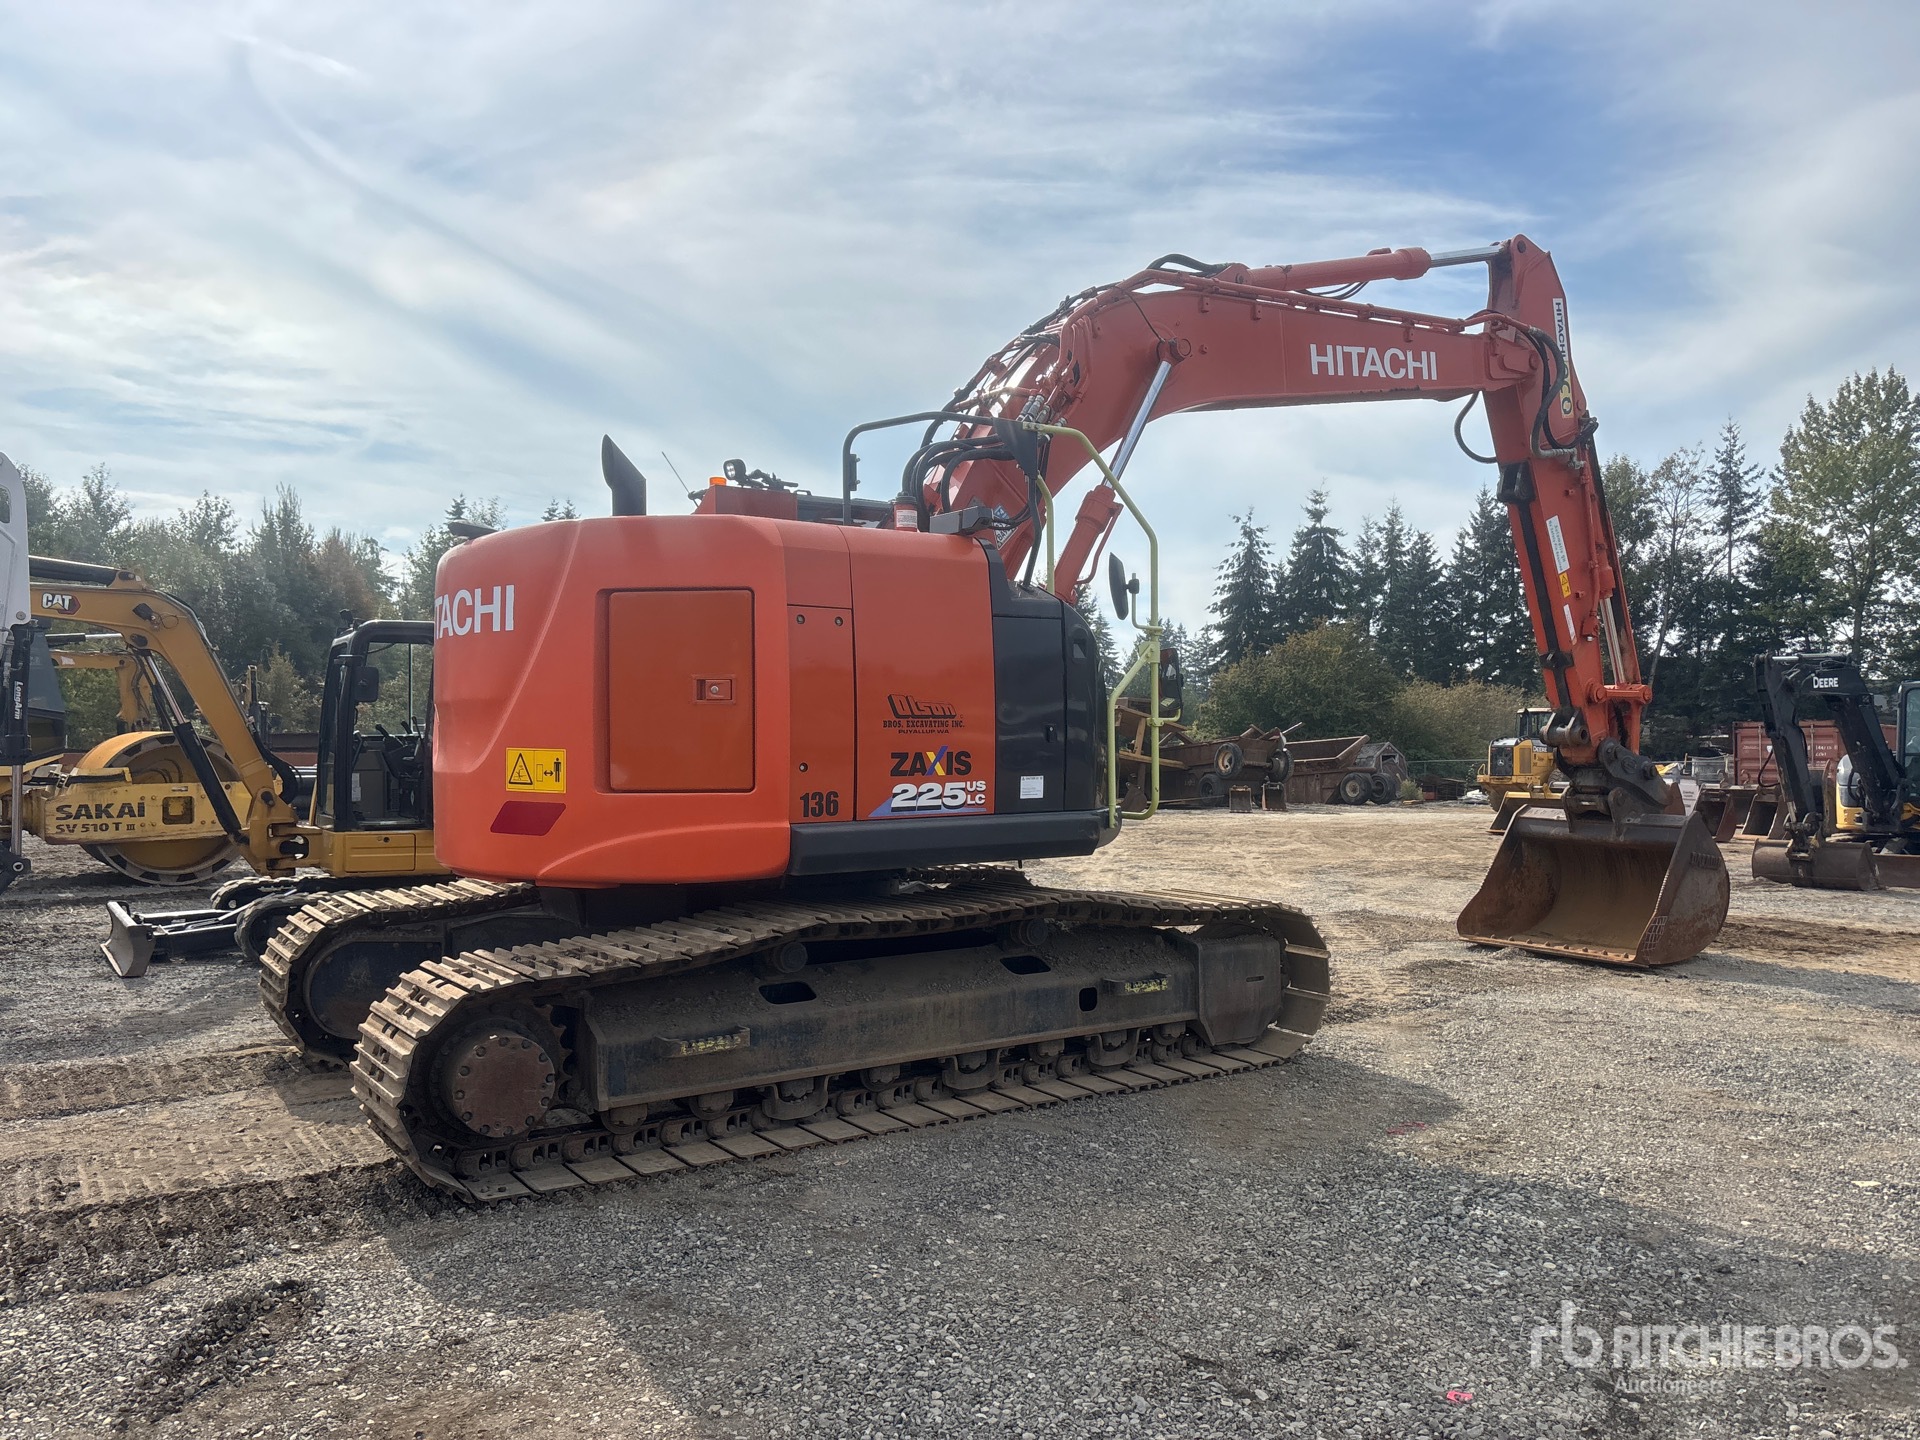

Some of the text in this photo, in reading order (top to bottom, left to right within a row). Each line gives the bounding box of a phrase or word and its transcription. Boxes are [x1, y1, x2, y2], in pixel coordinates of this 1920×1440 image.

[1310, 343, 1438, 381] HITACHI
[42, 593, 72, 610] CAT
[1813, 677, 1839, 688] DEERE
[14, 681, 24, 720] LongArm
[887, 694, 957, 719] Olson
[906, 720, 949, 728] EXCAVATING
[951, 720, 965, 728] INC.
[890, 746, 972, 777] ZAXIS
[800, 790, 839, 818] 136
[890, 781, 987, 813] 225 US
[966, 793, 986, 805] LC
[56, 802, 145, 820] SAKAI
[56, 824, 78, 833] SV
